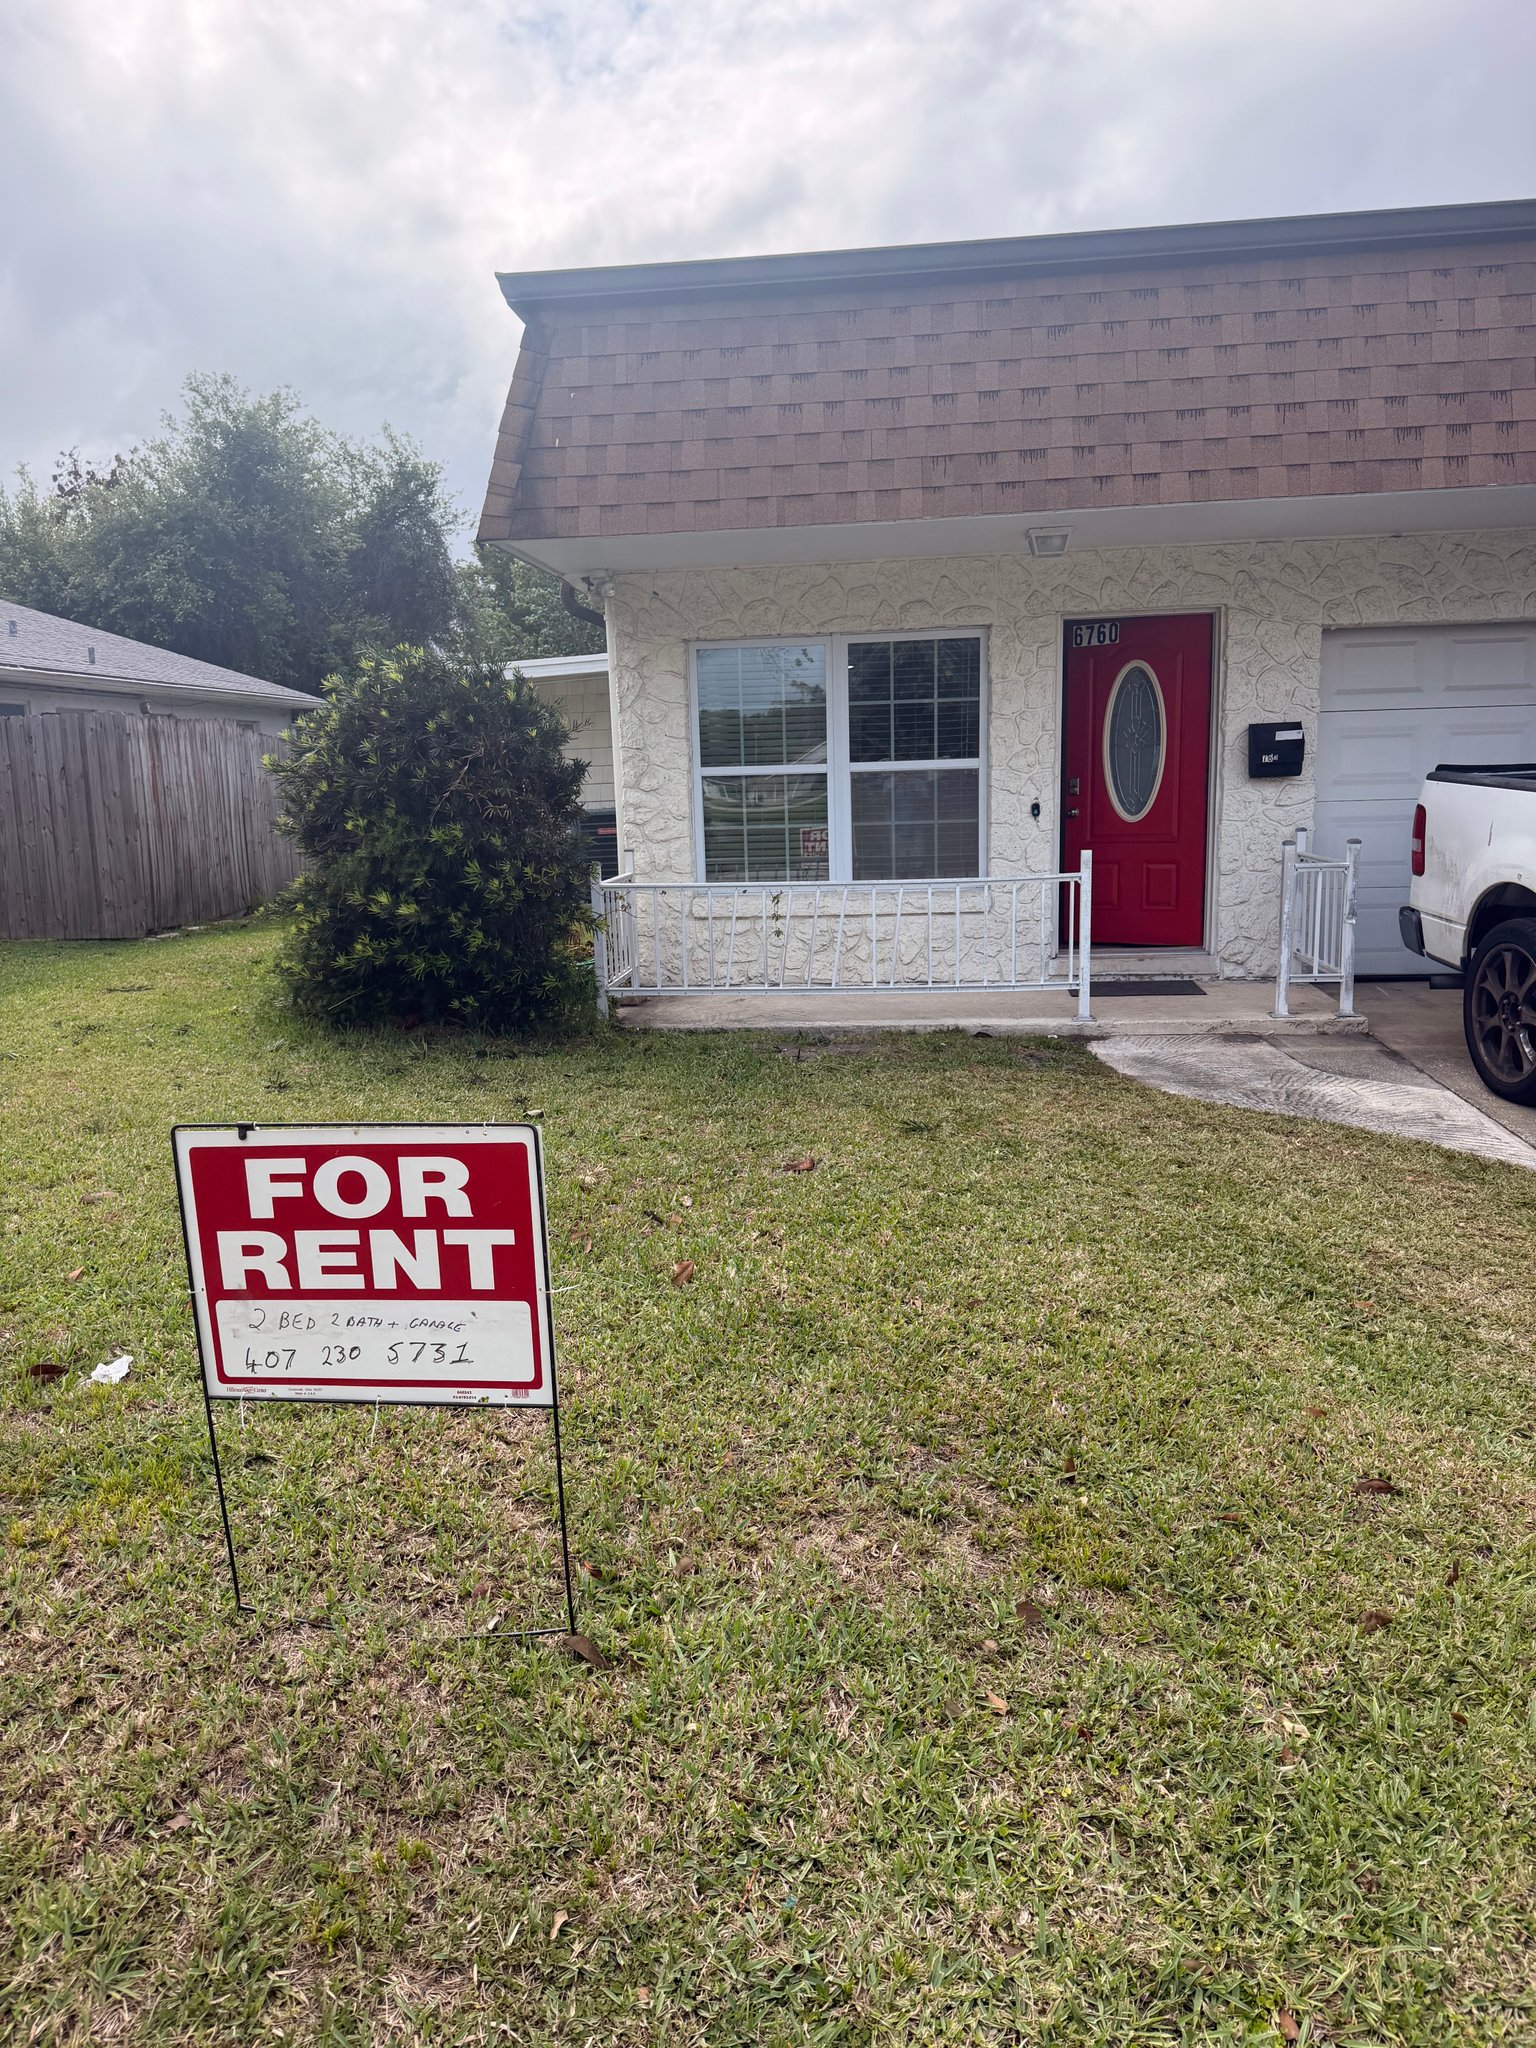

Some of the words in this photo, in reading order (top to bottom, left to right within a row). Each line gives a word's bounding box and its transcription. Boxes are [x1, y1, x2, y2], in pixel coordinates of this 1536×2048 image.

[1074, 622, 1119, 646] 6760
[244, 1155, 474, 1219] FOR
[216, 1229, 516, 1290] RENT
[248, 1308, 266, 1331] 2
[279, 1311, 316, 1330] BED
[331, 1312, 340, 1327] 2
[346, 1315, 383, 1328] BATH
[387, 1320, 399, 1329] +
[409, 1317, 467, 1332] GARAGE
[245, 1346, 297, 1374] 407
[321, 1345, 361, 1367] 230
[387, 1341, 475, 1365] 5731
